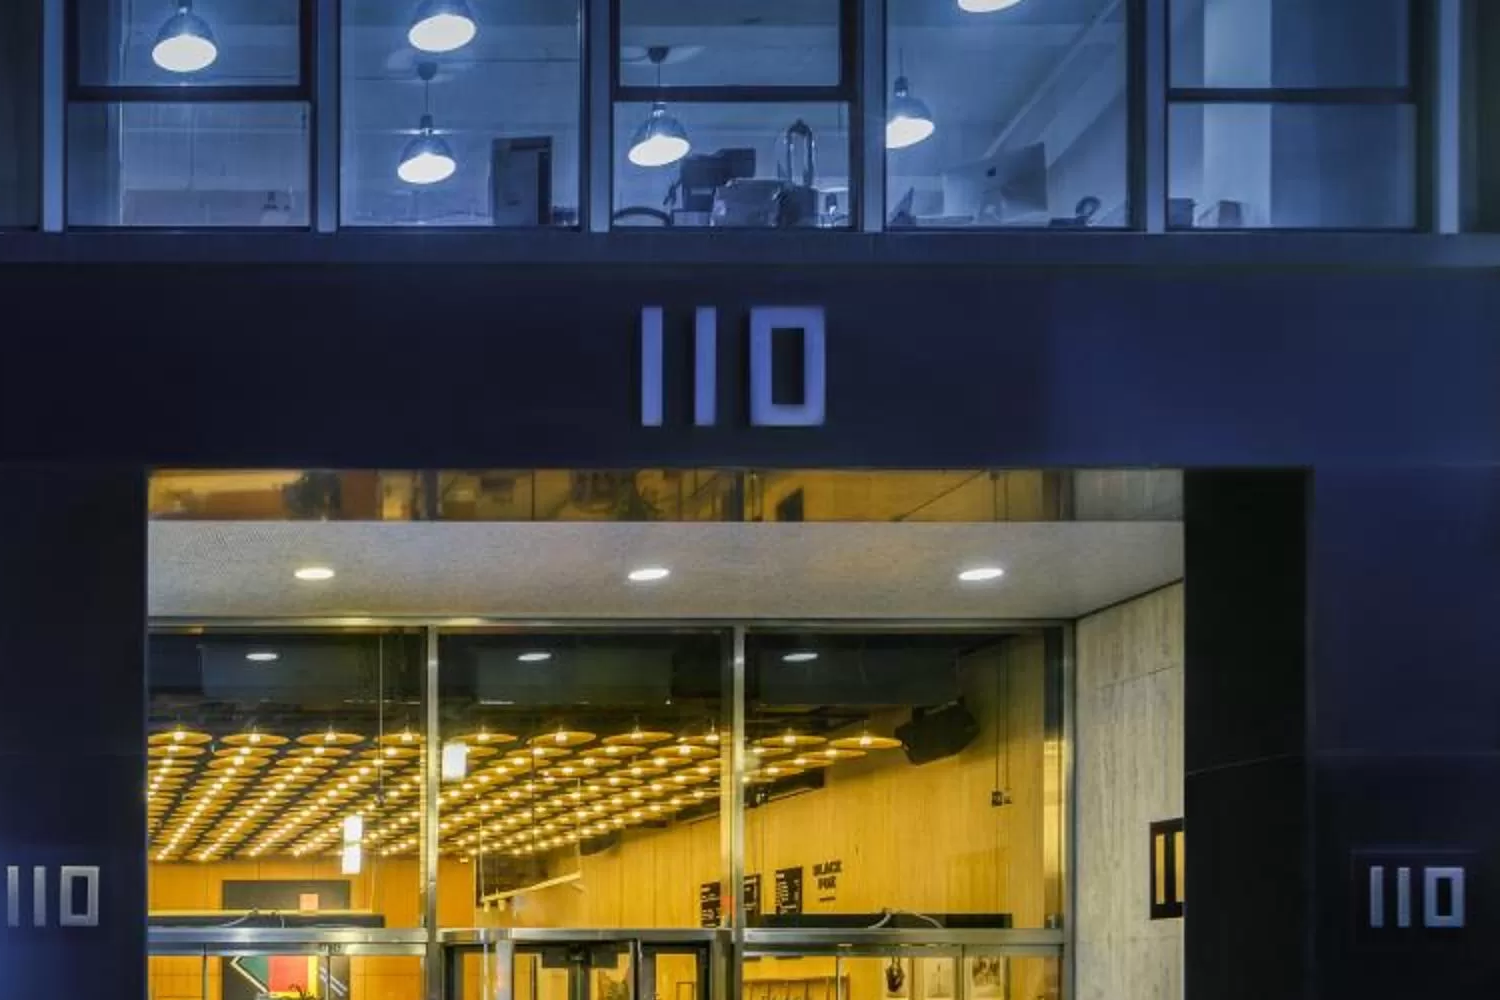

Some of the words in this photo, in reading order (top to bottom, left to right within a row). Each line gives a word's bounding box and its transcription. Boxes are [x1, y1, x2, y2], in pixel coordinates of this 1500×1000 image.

[641, 306, 825, 426] 110
[7, 865, 100, 927] 110
[1370, 866, 1465, 927] 110
